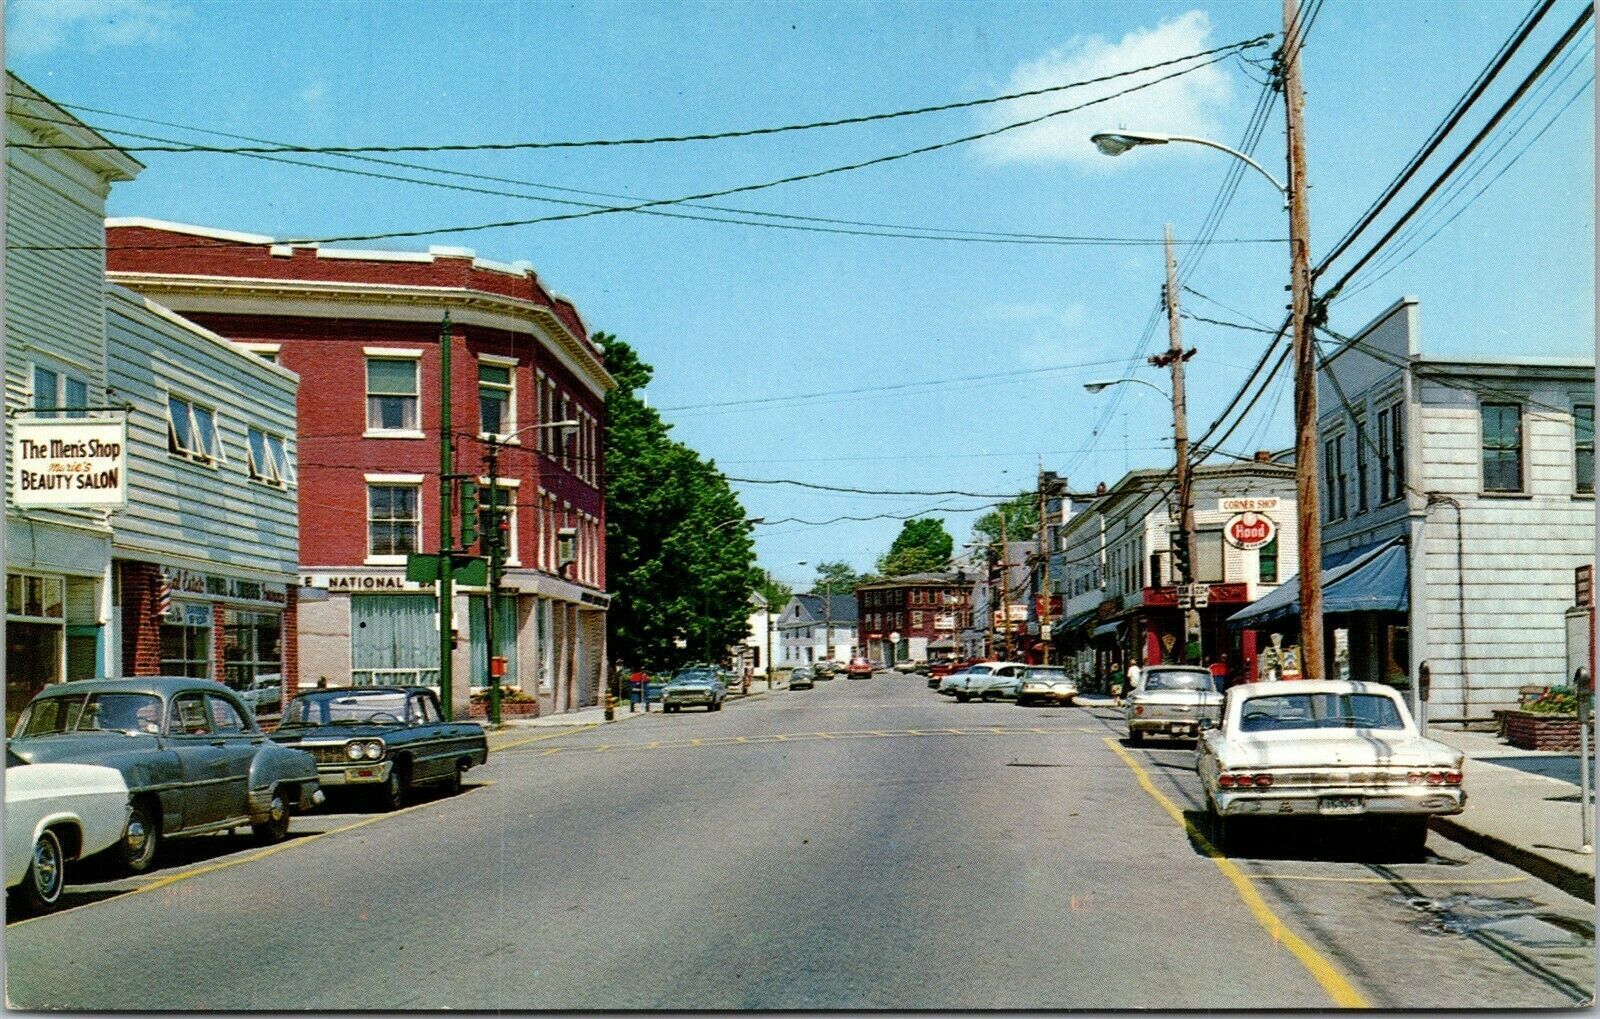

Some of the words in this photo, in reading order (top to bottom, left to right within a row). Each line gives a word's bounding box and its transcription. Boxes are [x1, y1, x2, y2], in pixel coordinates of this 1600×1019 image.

[20, 439, 47, 459] The
[50, 439, 86, 459] Men's
[88, 439, 120, 461] Shop
[21, 469, 73, 490] BEAUTY
[76, 467, 119, 490] SALON
[1223, 500, 1254, 510] CORNER
[1256, 499, 1278, 509] SHOP
[1235, 524, 1265, 539] Hood
[329, 577, 404, 588] NATIONAL
